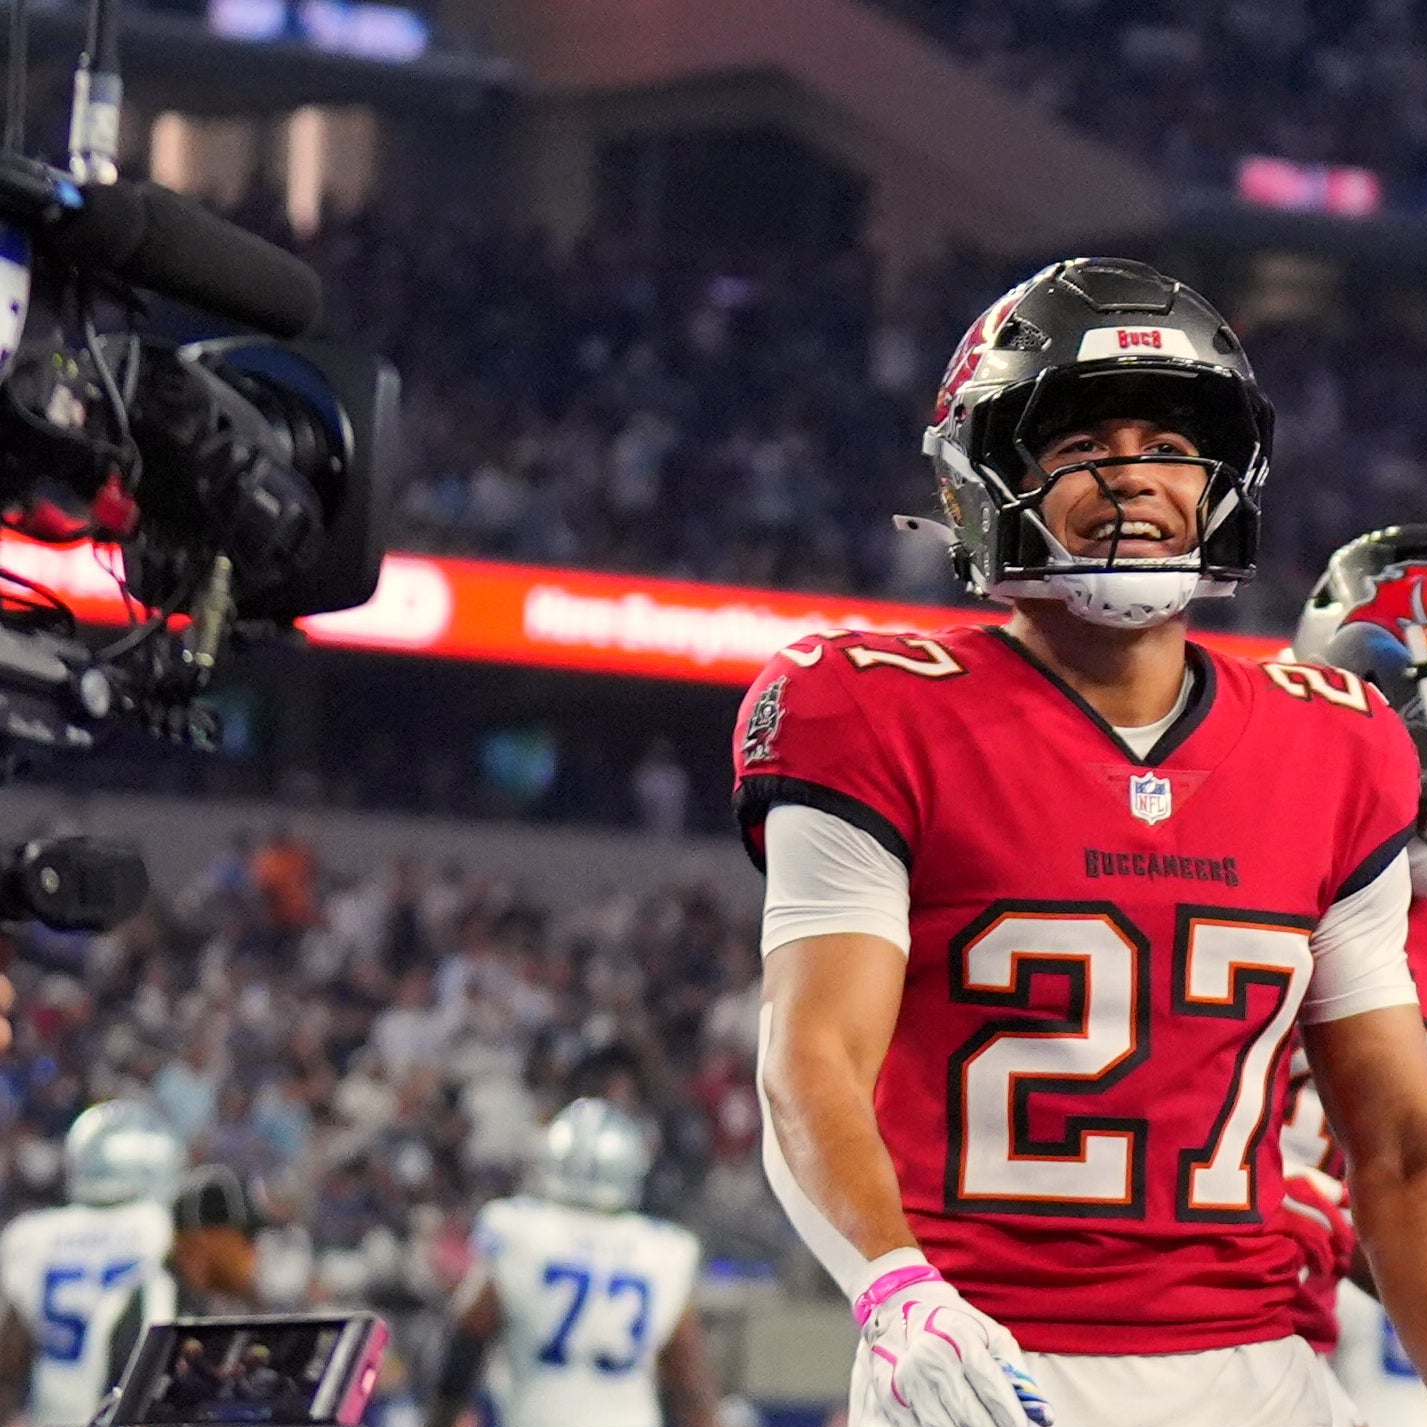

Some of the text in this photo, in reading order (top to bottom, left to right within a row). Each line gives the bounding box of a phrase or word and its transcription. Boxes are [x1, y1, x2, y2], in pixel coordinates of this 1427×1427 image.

[1084, 847, 1240, 887] BUCCANEERS
[944, 898, 1318, 1224] 27
[537, 1264, 655, 1374] 73
